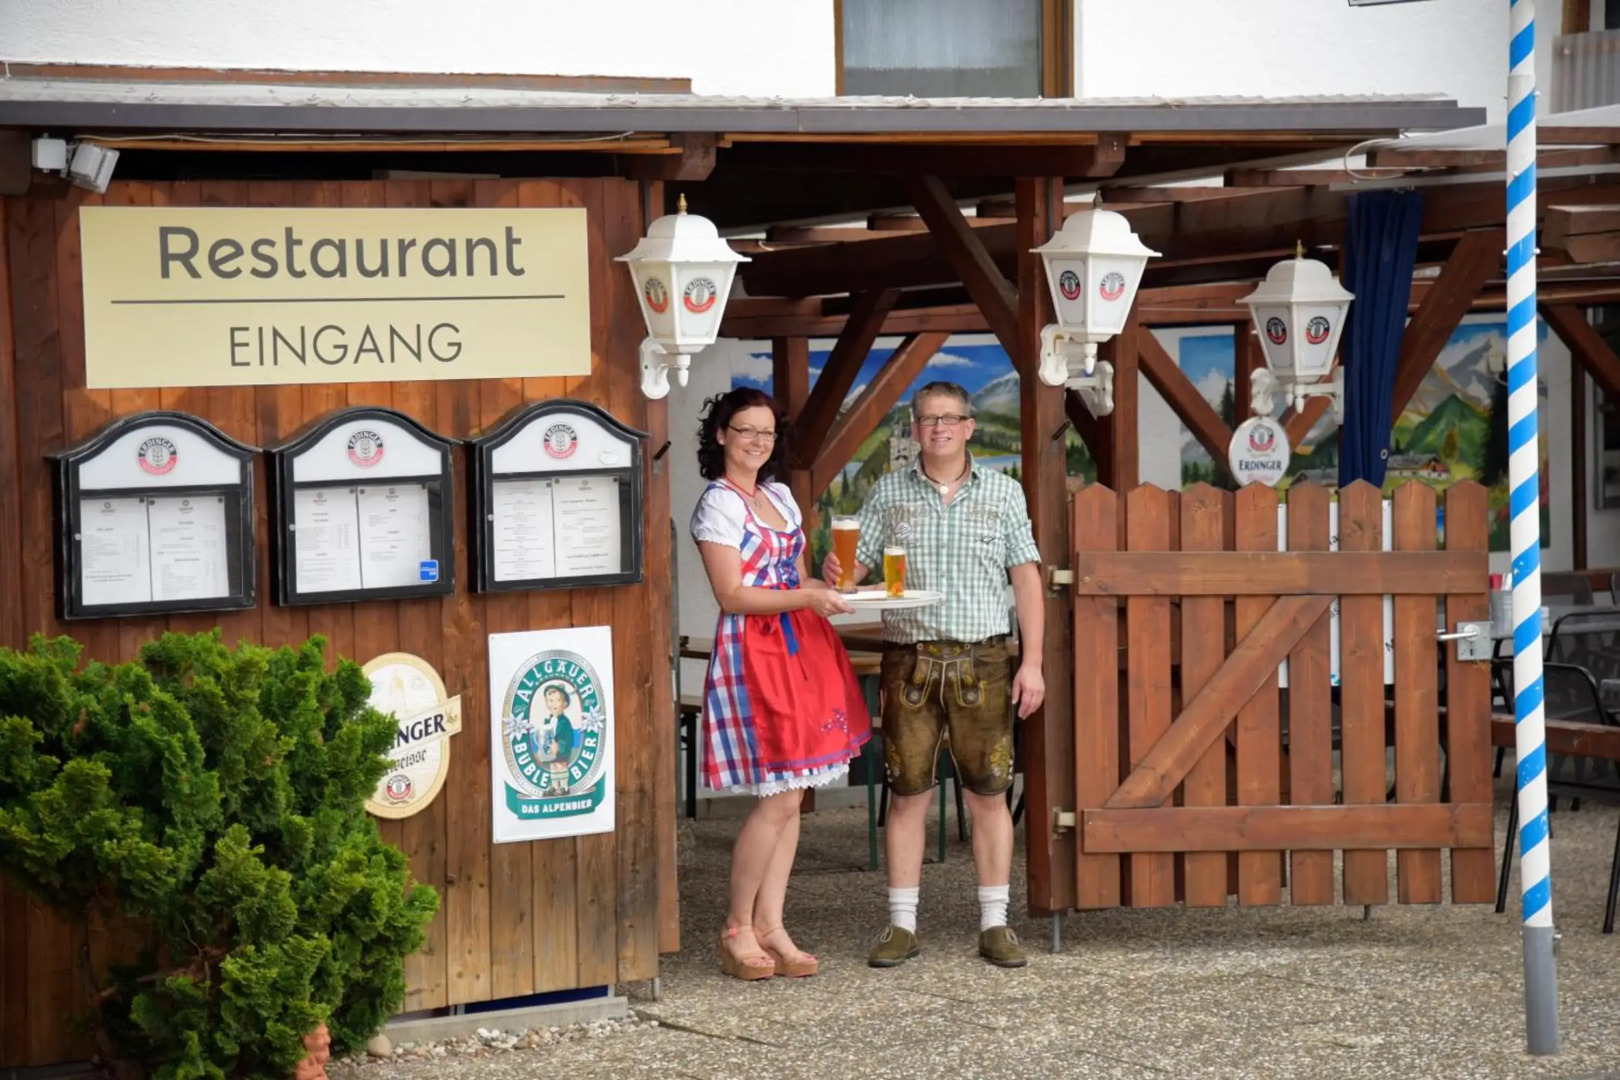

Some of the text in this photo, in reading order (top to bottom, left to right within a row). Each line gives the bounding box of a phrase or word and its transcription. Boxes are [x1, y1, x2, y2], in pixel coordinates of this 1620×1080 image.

[158, 226, 526, 280] Restaurant
[229, 323, 463, 367] EINGANG
[1239, 460, 1282, 471] ERDINGER
[516, 659, 594, 703] ALLGÄUER
[397, 713, 446, 747] NGER
[570, 737, 597, 780] BIER
[521, 798, 593, 814] DAS ALPENBIER
